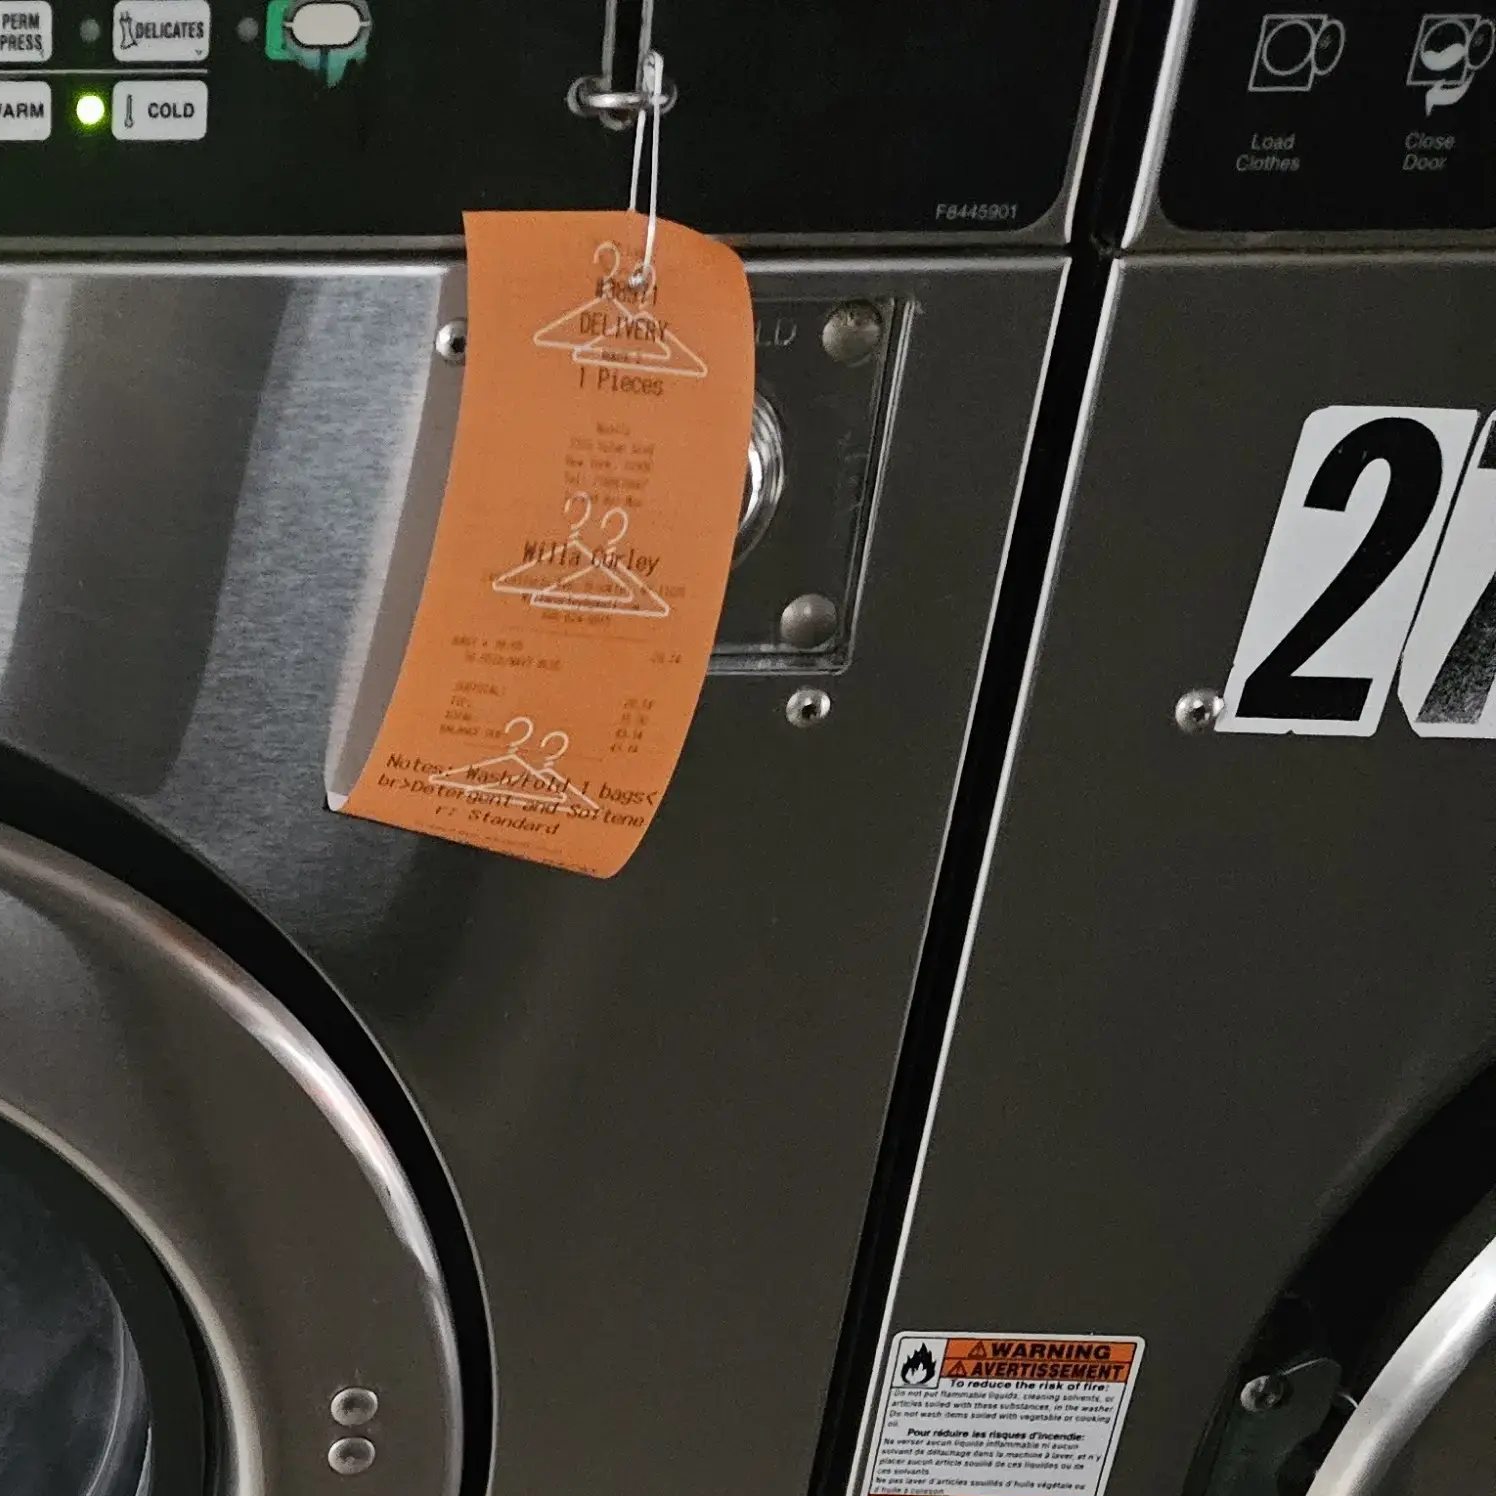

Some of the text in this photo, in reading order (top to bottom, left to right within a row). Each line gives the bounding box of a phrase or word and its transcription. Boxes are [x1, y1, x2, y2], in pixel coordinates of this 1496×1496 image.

[1, 13, 40, 31] PERM
[135, 22, 205, 40] DELICATES
[0, 34, 43, 52] PRESS
[147, 102, 195, 119] COLD
[1251, 133, 1296, 150] Load
[1404, 132, 1455, 150] Close
[1236, 154, 1301, 172] Clothes
[1402, 154, 1448, 171] Door
[580, 312, 671, 343] DELIVERY
[598, 366, 664, 396] Pieces
[386, 752, 453, 777] Notes:
[468, 808, 560, 835] Standard
[991, 1342, 1111, 1360] WARNING
[971, 1361, 1125, 1380] AVERTISSEMENT
[950, 1379, 1110, 1392] To reduce the risk of fire:
[907, 1427, 931, 1437] Pour
[933, 1428, 969, 1438] réduire
[972, 1429, 986, 1438] les
[989, 1430, 1026, 1440] risques
